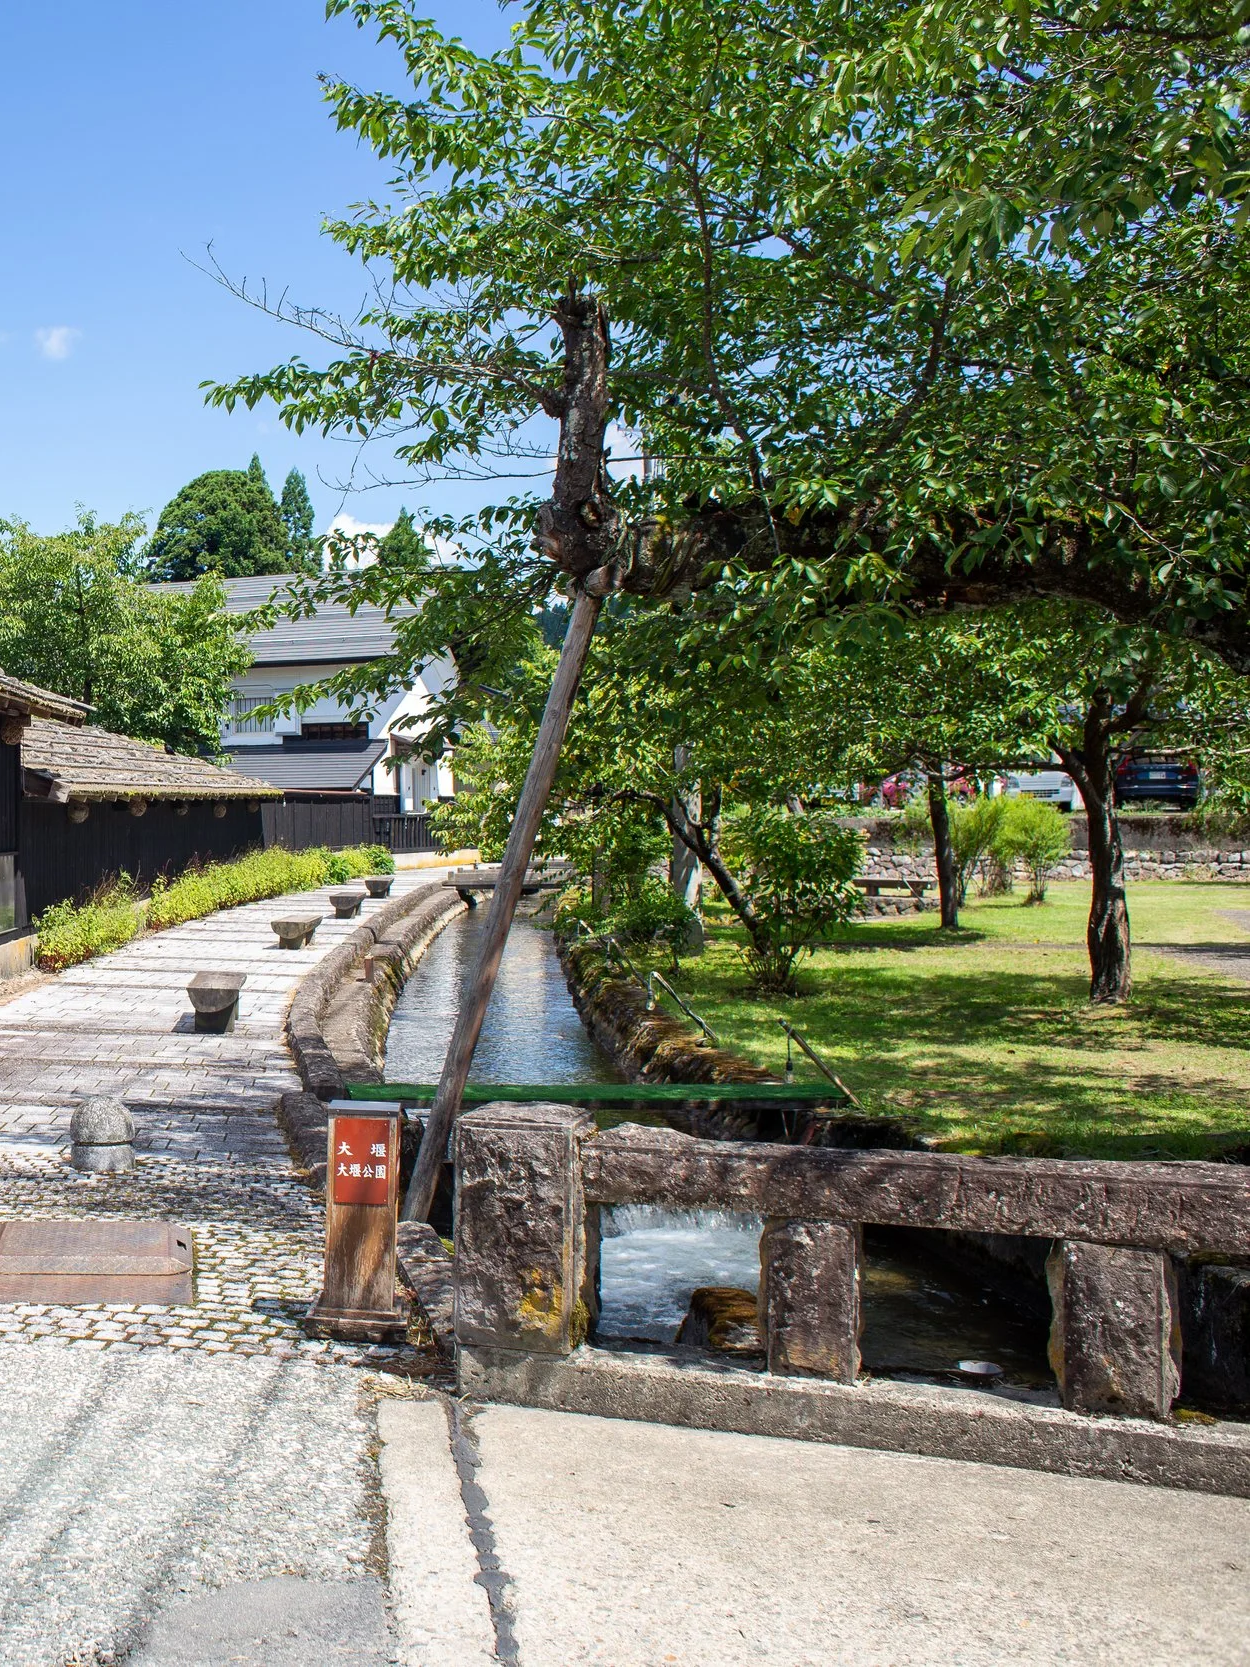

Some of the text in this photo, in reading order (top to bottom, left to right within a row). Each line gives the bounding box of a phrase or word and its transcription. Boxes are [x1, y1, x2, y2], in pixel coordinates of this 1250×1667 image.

[337, 1141, 387, 1158] 大堰
[336, 1162, 387, 1180] 大堰公園
